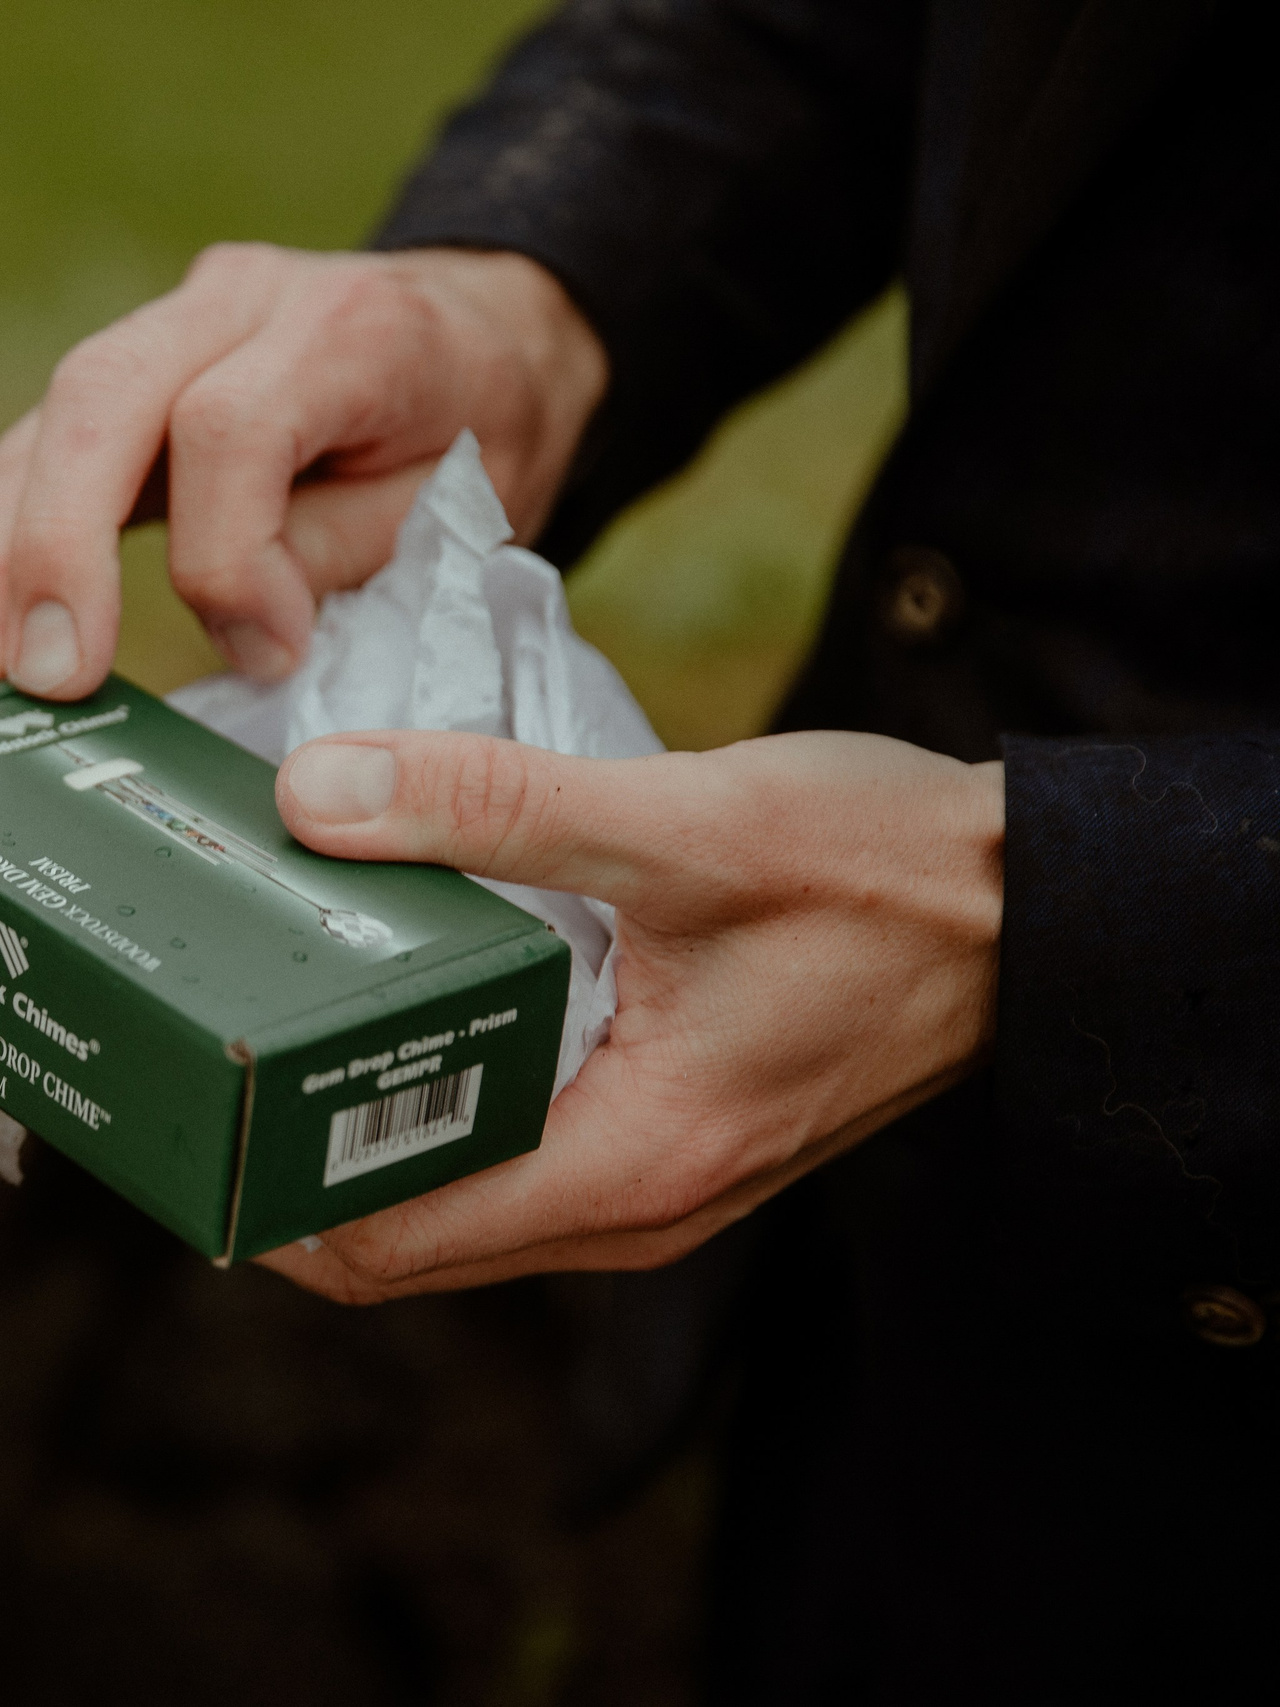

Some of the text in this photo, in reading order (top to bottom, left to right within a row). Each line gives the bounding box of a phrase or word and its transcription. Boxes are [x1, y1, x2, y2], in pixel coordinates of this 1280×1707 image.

[17, 877, 68, 909] GEM
[28, 856, 91, 894] PRISM
[347, 1050, 395, 1079] Drop
[397, 1030, 455, 1061] Chime
[469, 1007, 518, 1037] Prism
